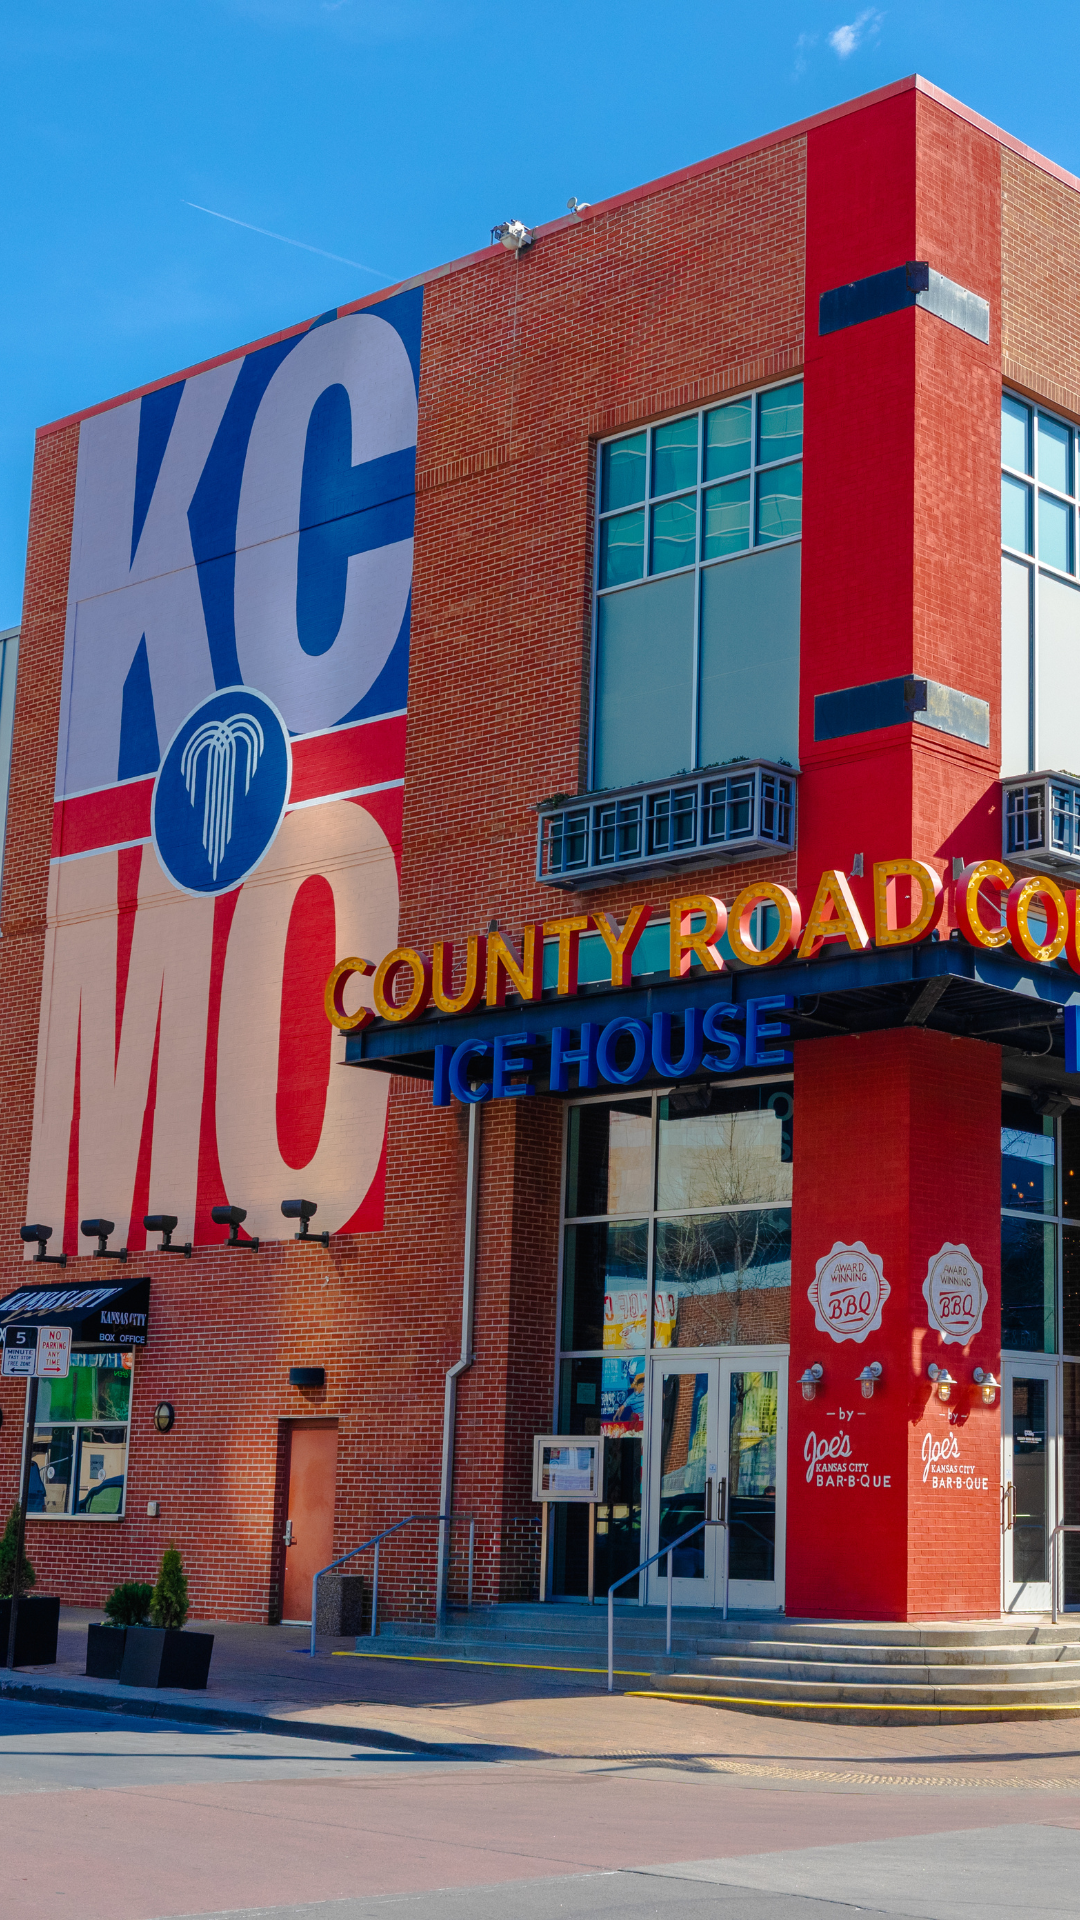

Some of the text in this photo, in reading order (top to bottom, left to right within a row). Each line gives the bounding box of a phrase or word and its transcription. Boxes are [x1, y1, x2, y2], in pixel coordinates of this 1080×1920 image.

[55, 312, 418, 797] KC
[324, 858, 944, 1031] COUNTY ROAD
[24, 800, 400, 1261] MO
[432, 994, 794, 1107] ICE HOUSE
[833, 1262, 864, 1274] AWARD
[943, 1264, 968, 1276] AWARD
[830, 1271, 868, 1283] WINNING
[939, 1275, 972, 1288] WINNING
[828, 1290, 871, 1320] BBQ
[939, 1290, 976, 1319] BBQ
[100, 1310, 147, 1327] KANSAS CITY
[16, 1331, 26, 1344] 5
[49, 1330, 62, 1341] NO
[99, 1333, 146, 1344] BOX OFFICE
[42, 1341, 67, 1350] PARKING
[46, 1358, 60, 1366] TIME
[838, 1407, 854, 1422] by
[947, 1410, 959, 1422] by
[803, 1430, 853, 1483] Joe's
[921, 1431, 960, 1483] Joe's
[815, 1462, 869, 1473] KANSAS CITY
[931, 1464, 976, 1475] KANSAS CITY
